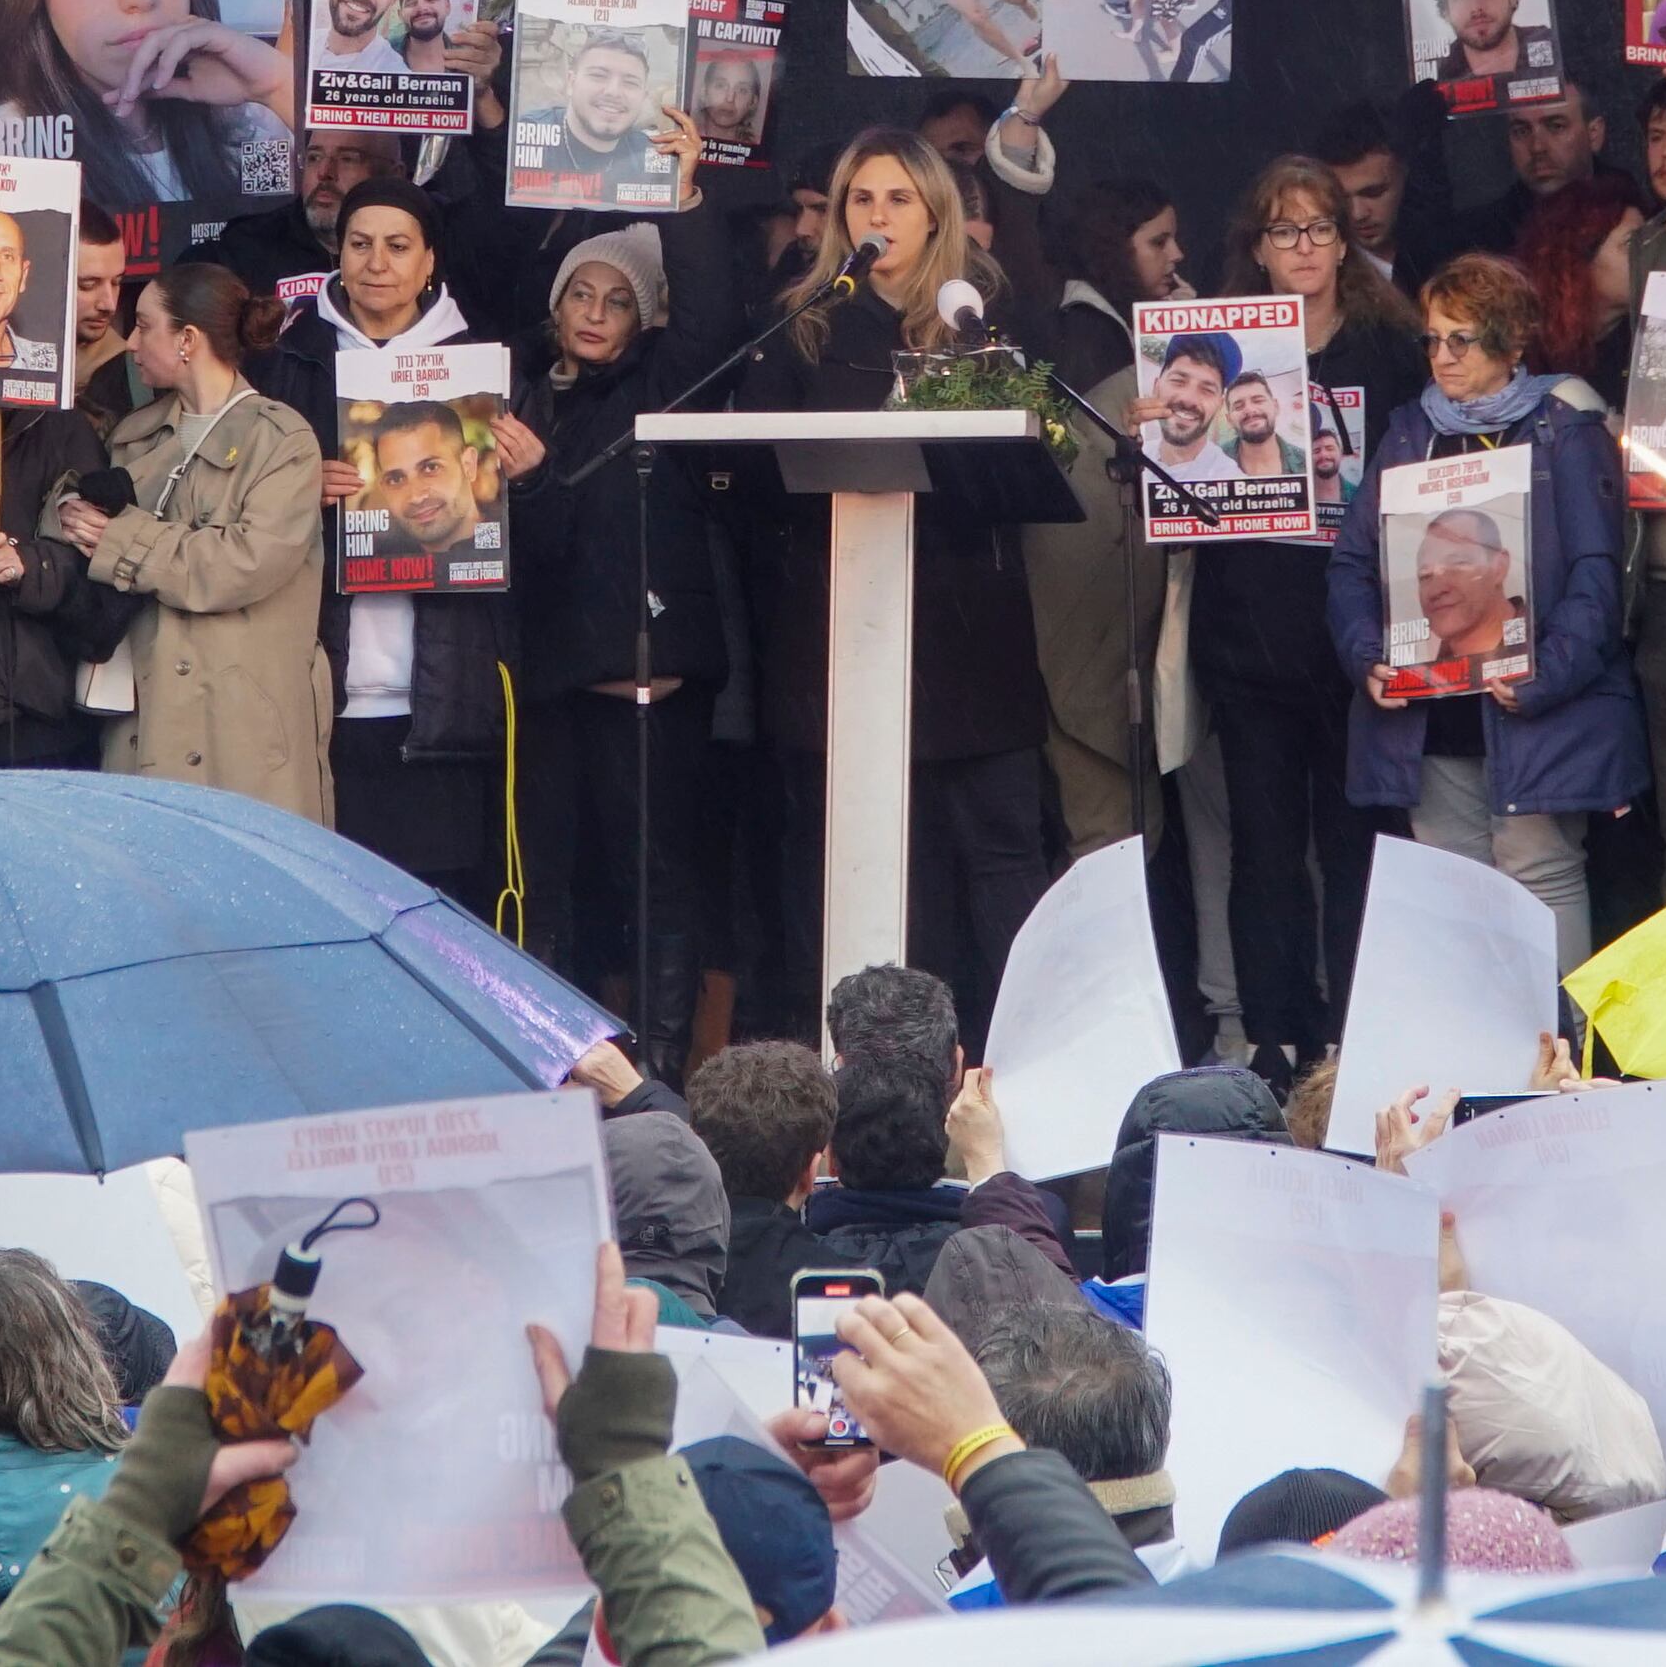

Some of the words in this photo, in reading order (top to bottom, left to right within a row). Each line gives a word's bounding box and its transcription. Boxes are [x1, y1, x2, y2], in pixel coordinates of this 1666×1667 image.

[697, 19, 713, 37] IN
[715, 22, 781, 46] CAPTIVITY
[1414, 37, 1451, 62] BRING
[319, 73, 392, 90] Ziv&Gali
[398, 76, 462, 93] Berman
[325, 91, 340, 102] 26
[345, 92, 379, 106] years
[384, 92, 404, 104] old
[408, 93, 455, 106] Israelis
[314, 109, 352, 122] BRING
[355, 111, 390, 124] THEM
[393, 113, 429, 126] HOME
[431, 114, 464, 128] NOW!
[516, 122, 561, 147] BRING
[515, 146, 543, 169] HIM
[718, 142, 751, 157] running
[1144, 304, 1294, 332] KIDNAPPED
[416, 353, 445, 366] אוריאל
[391, 370, 414, 383] URIEL
[416, 368, 449, 382] BARUCH
[413, 383, 430, 398] (35)
[1234, 480, 1301, 496] Berman
[1162, 502, 1178, 514] 26
[1222, 499, 1242, 512] old
[1246, 497, 1296, 511] Israelis
[345, 509, 390, 534] BRING
[1153, 520, 1192, 535] BRING
[1234, 516, 1271, 532] HOME
[1273, 514, 1309, 529] NOW!
[346, 533, 374, 558] HIM
[346, 558, 387, 582] HOME
[391, 554, 433, 580] NOW!
[1390, 618, 1430, 645] BRING
[1390, 643, 1416, 667] HIM
